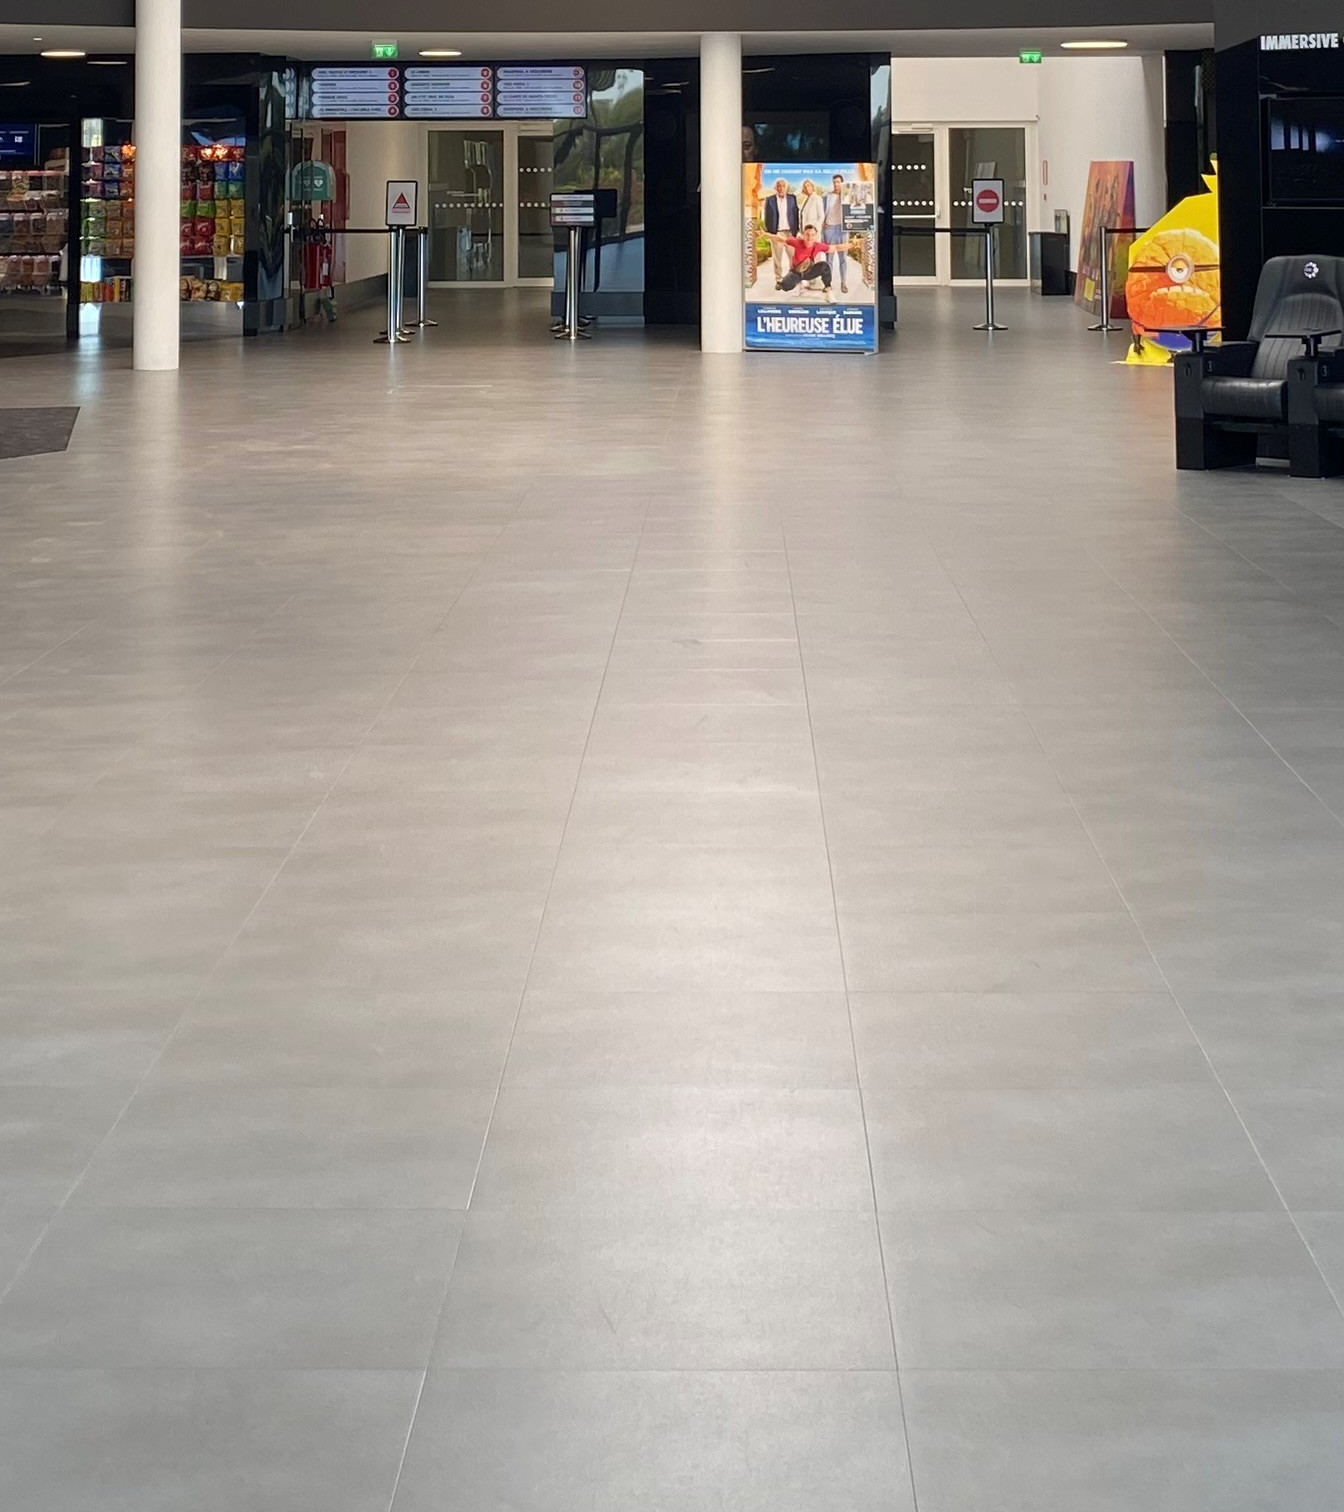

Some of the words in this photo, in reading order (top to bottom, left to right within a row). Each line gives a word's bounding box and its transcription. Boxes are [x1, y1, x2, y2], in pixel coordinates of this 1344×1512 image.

[1260, 33, 1339, 51] IMMERSIVE
[757, 316, 830, 334] L'HEUREUSE
[832, 314, 864, 335] ÉLUE
